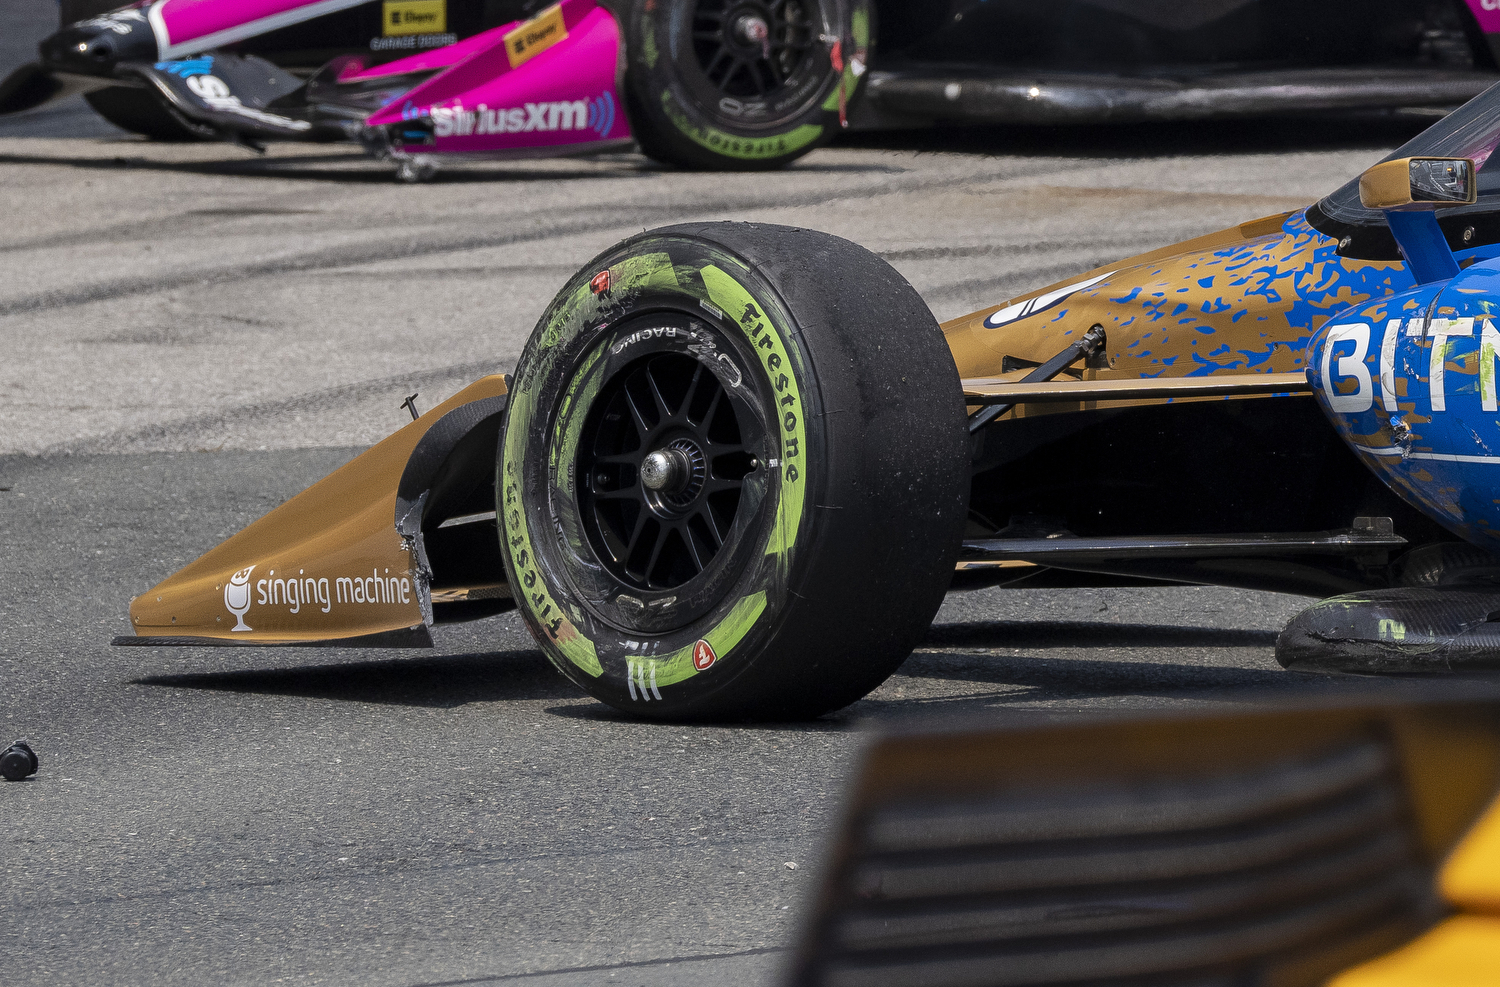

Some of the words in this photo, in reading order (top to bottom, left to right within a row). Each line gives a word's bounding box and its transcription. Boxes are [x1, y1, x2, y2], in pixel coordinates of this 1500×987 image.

[738, 301, 801, 485] Firestone
[257, 569, 331, 614] singing
[336, 567, 410, 604] machine
